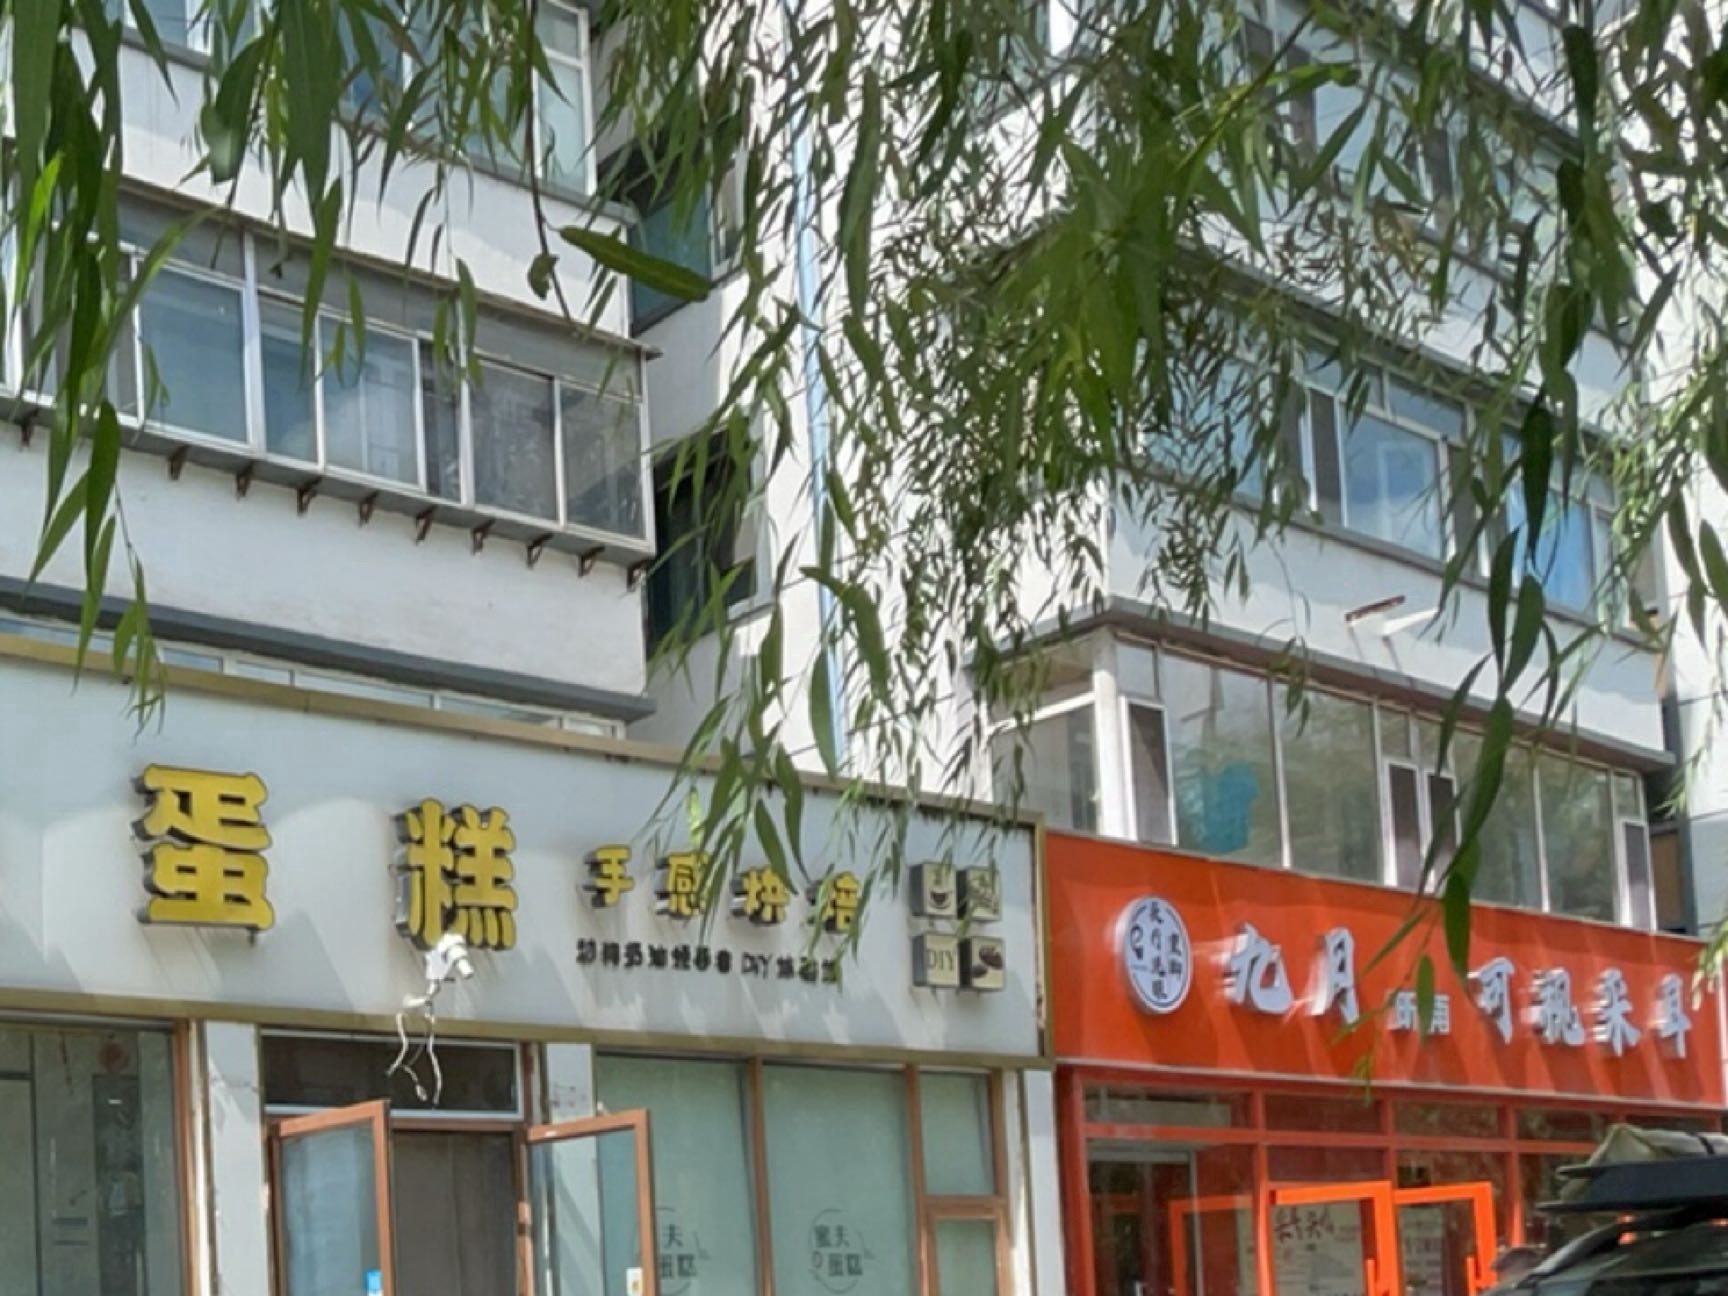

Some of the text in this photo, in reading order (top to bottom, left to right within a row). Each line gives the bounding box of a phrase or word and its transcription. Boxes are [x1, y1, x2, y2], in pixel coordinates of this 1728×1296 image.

[584, 845, 862, 934] 手感烘焙
[1225, 923, 1358, 1023] 九月
